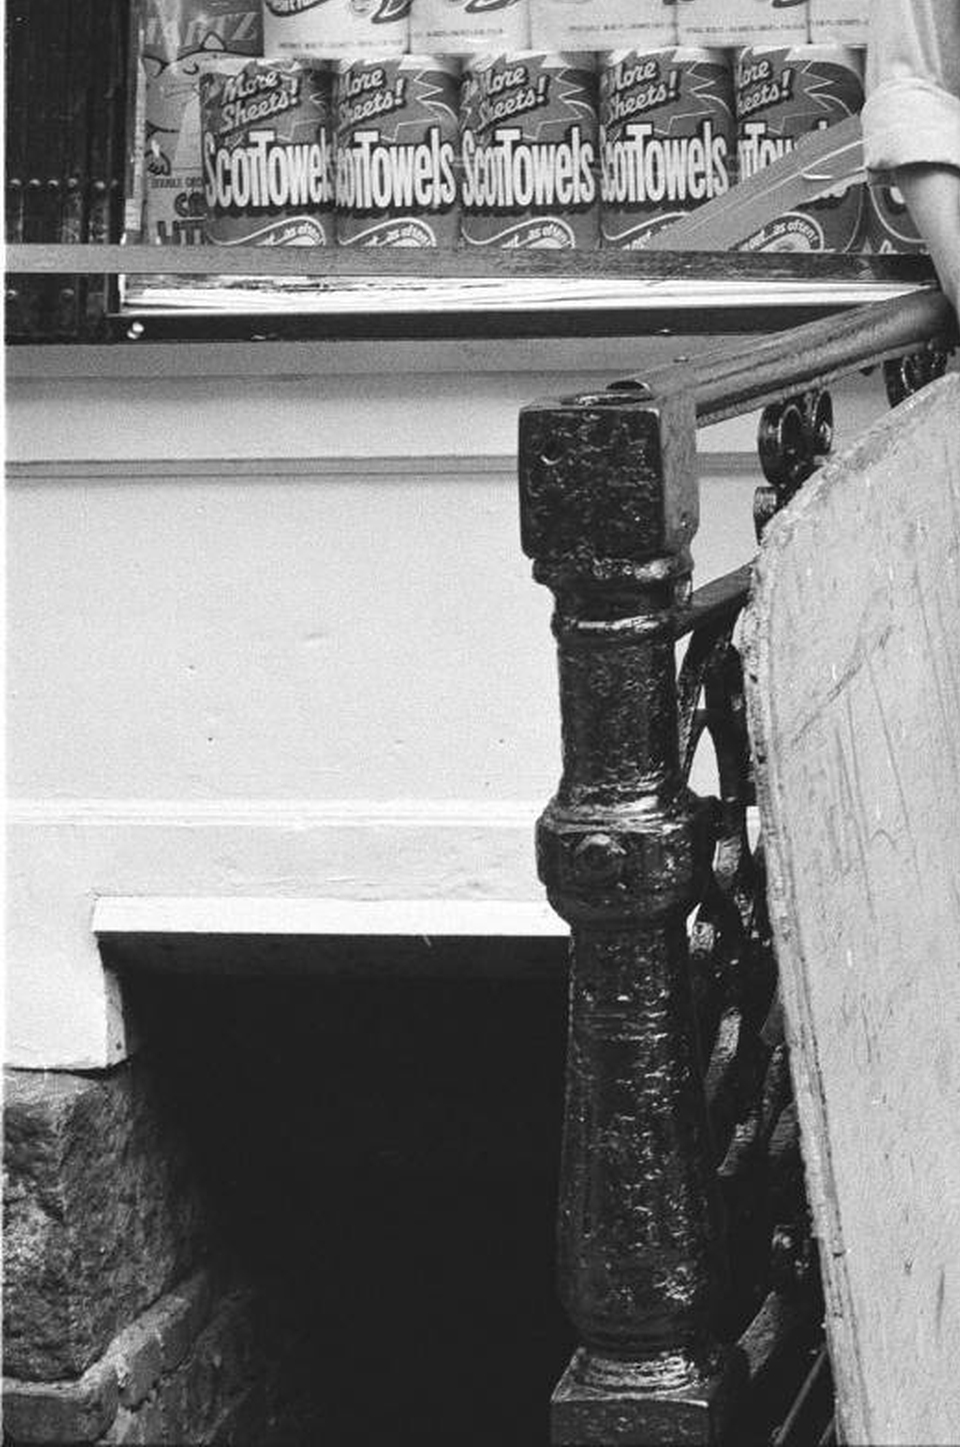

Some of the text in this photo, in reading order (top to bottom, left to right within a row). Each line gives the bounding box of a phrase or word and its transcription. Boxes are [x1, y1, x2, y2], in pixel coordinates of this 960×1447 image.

[220, 78, 299, 134] Sheets!
[222, 71, 280, 105] More
[461, 126, 595, 207] ScotTowels
